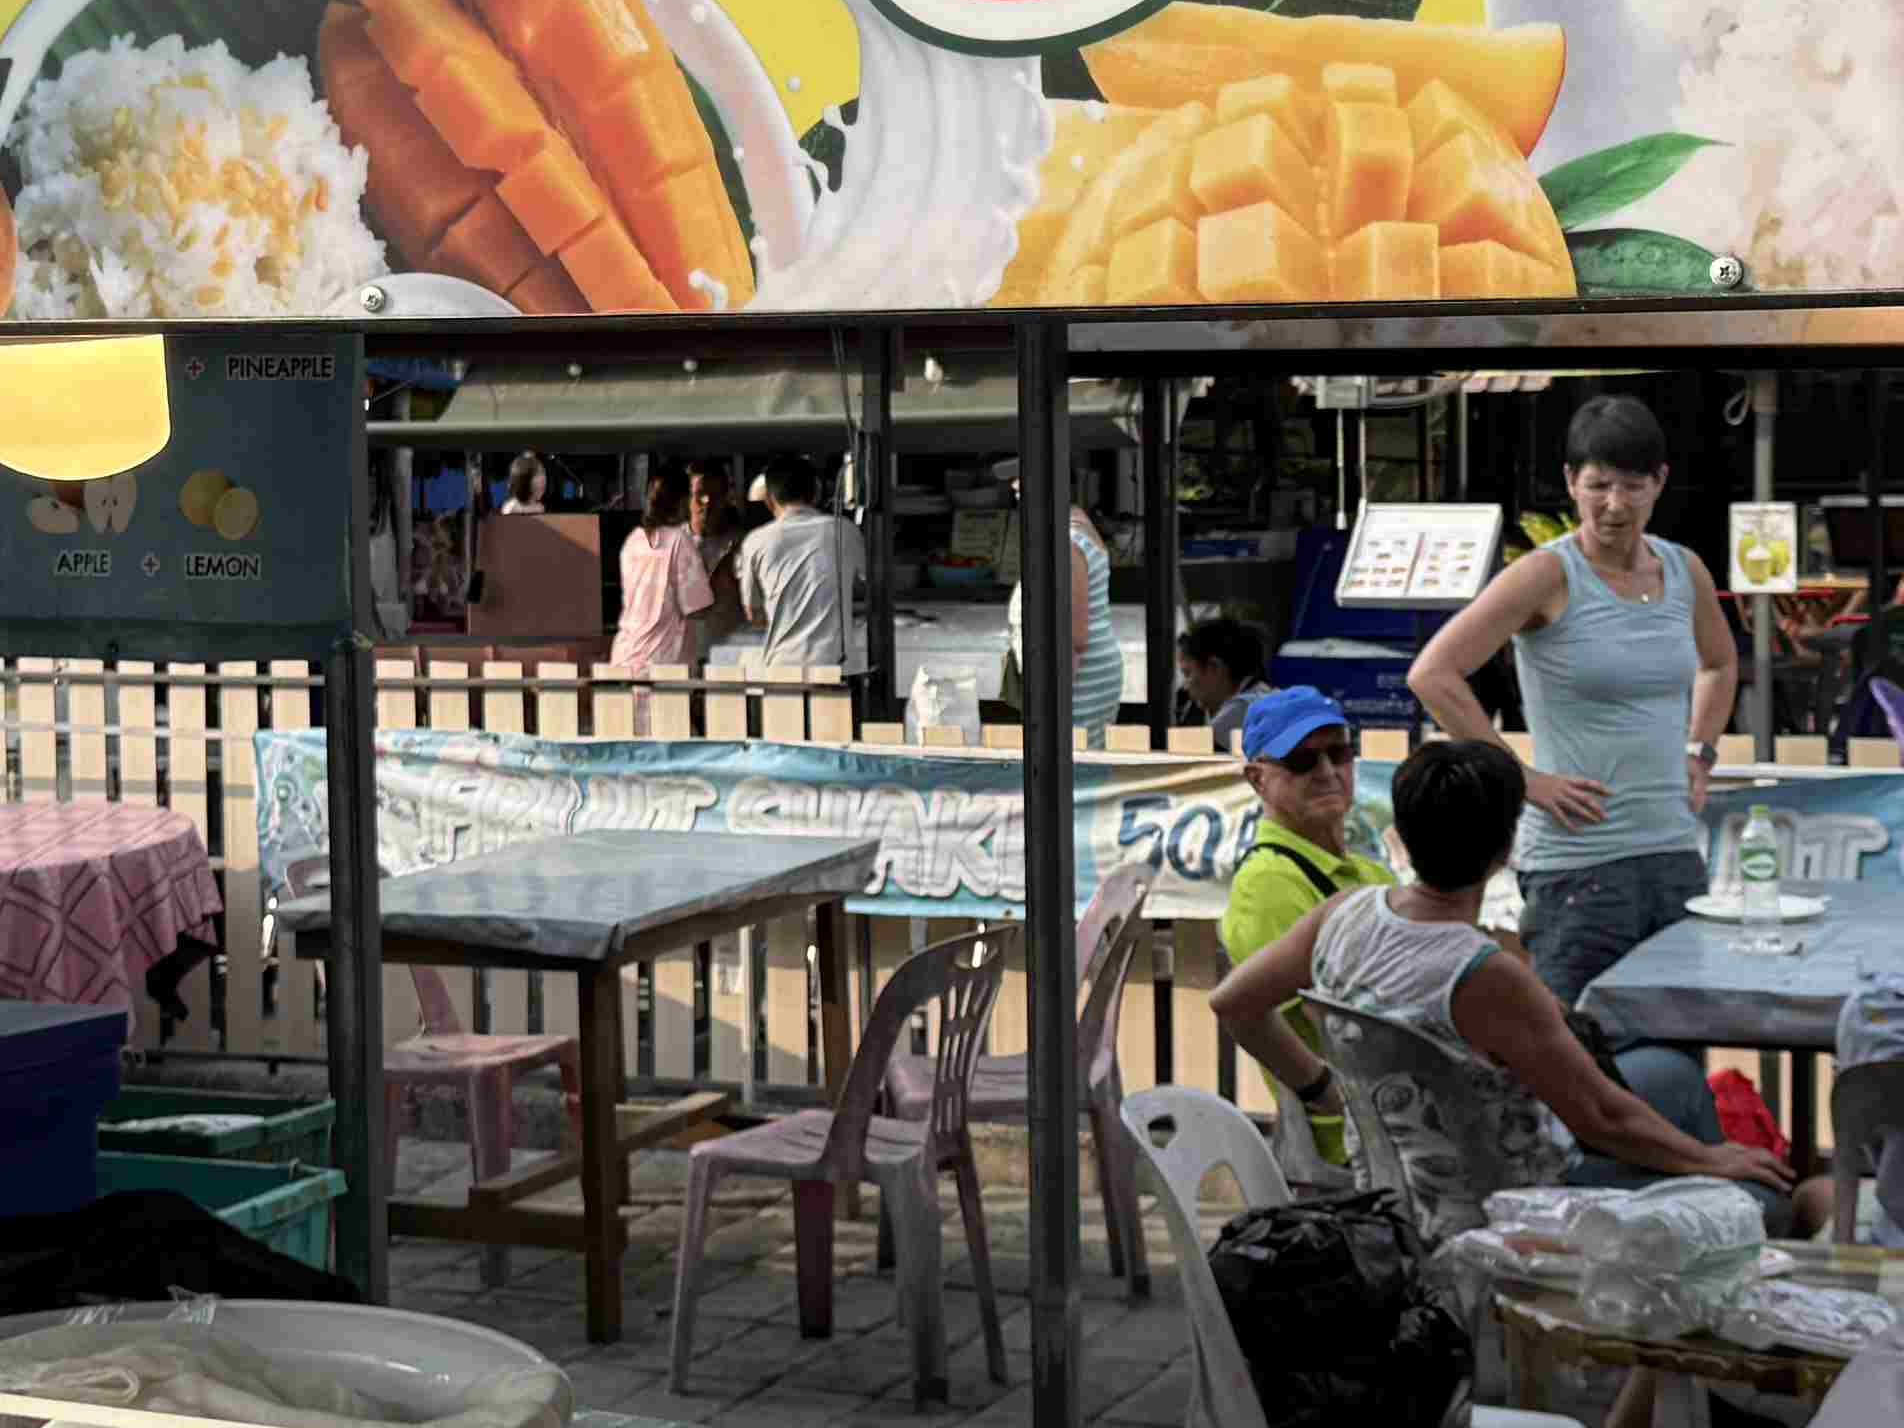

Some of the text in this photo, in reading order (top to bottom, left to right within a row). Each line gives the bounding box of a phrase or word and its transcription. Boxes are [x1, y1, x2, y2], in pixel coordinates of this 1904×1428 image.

[227, 357, 334, 379] PINEAPPLE
[56, 554, 110, 574] APPLE
[186, 558, 260, 578] LEMON
